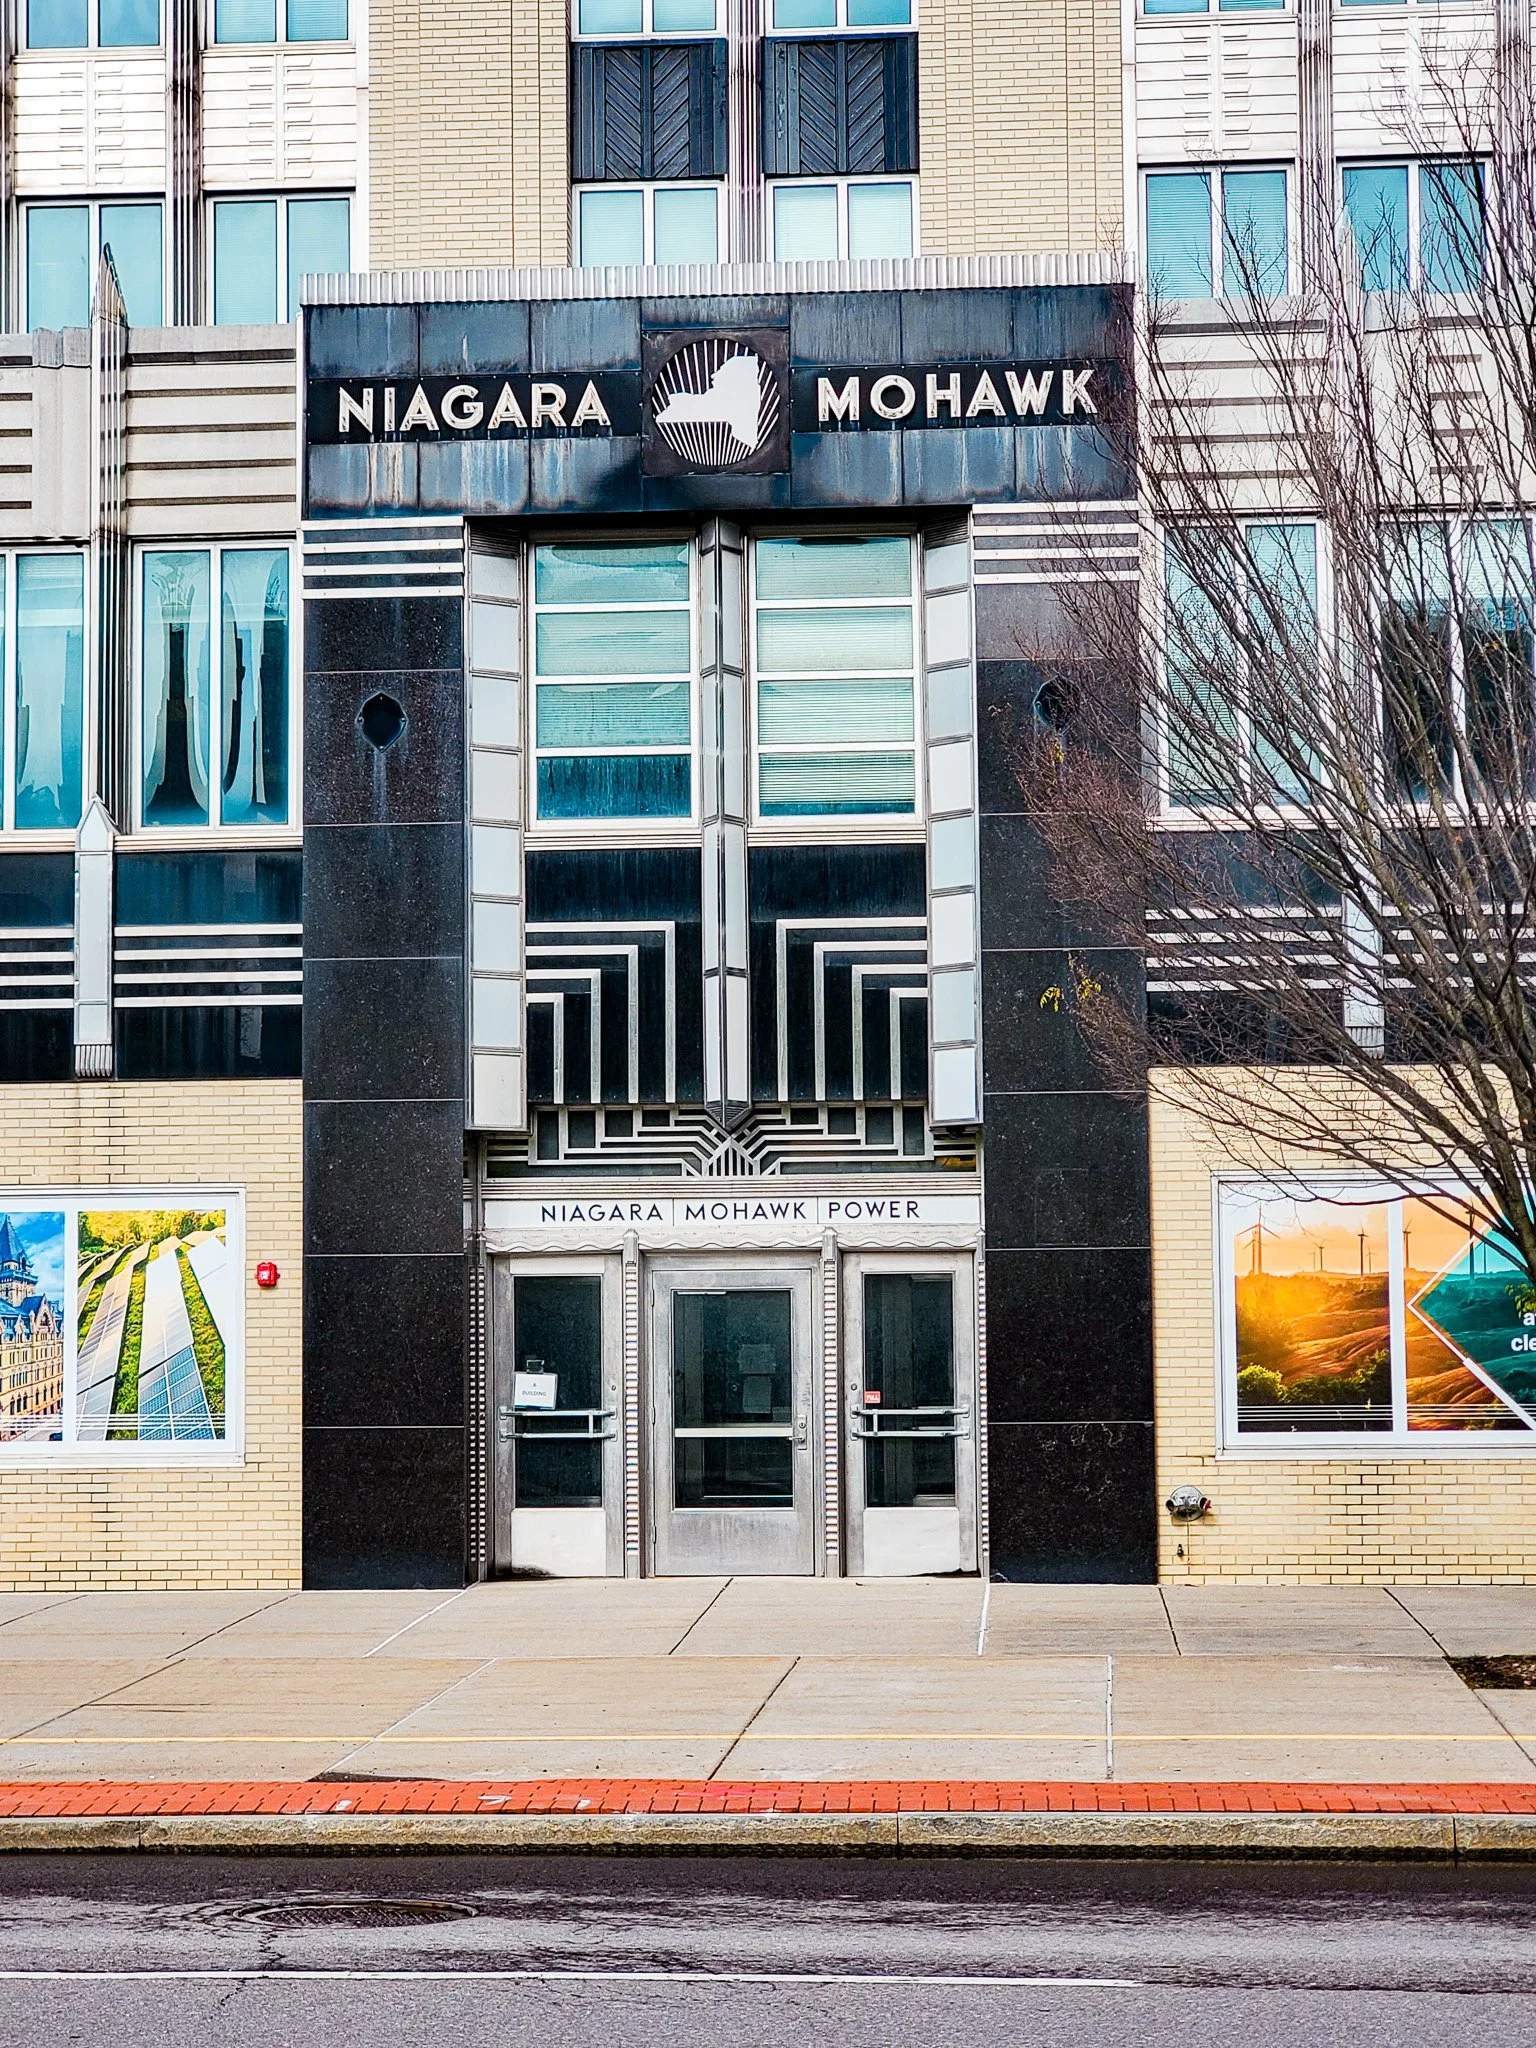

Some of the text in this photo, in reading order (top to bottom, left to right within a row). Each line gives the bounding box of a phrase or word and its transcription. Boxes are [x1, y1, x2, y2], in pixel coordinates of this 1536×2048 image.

[338, 369, 1099, 434] NIAGARA MOHAWK
[541, 1200, 920, 1222] NIAGARA MOHAWK POWER
